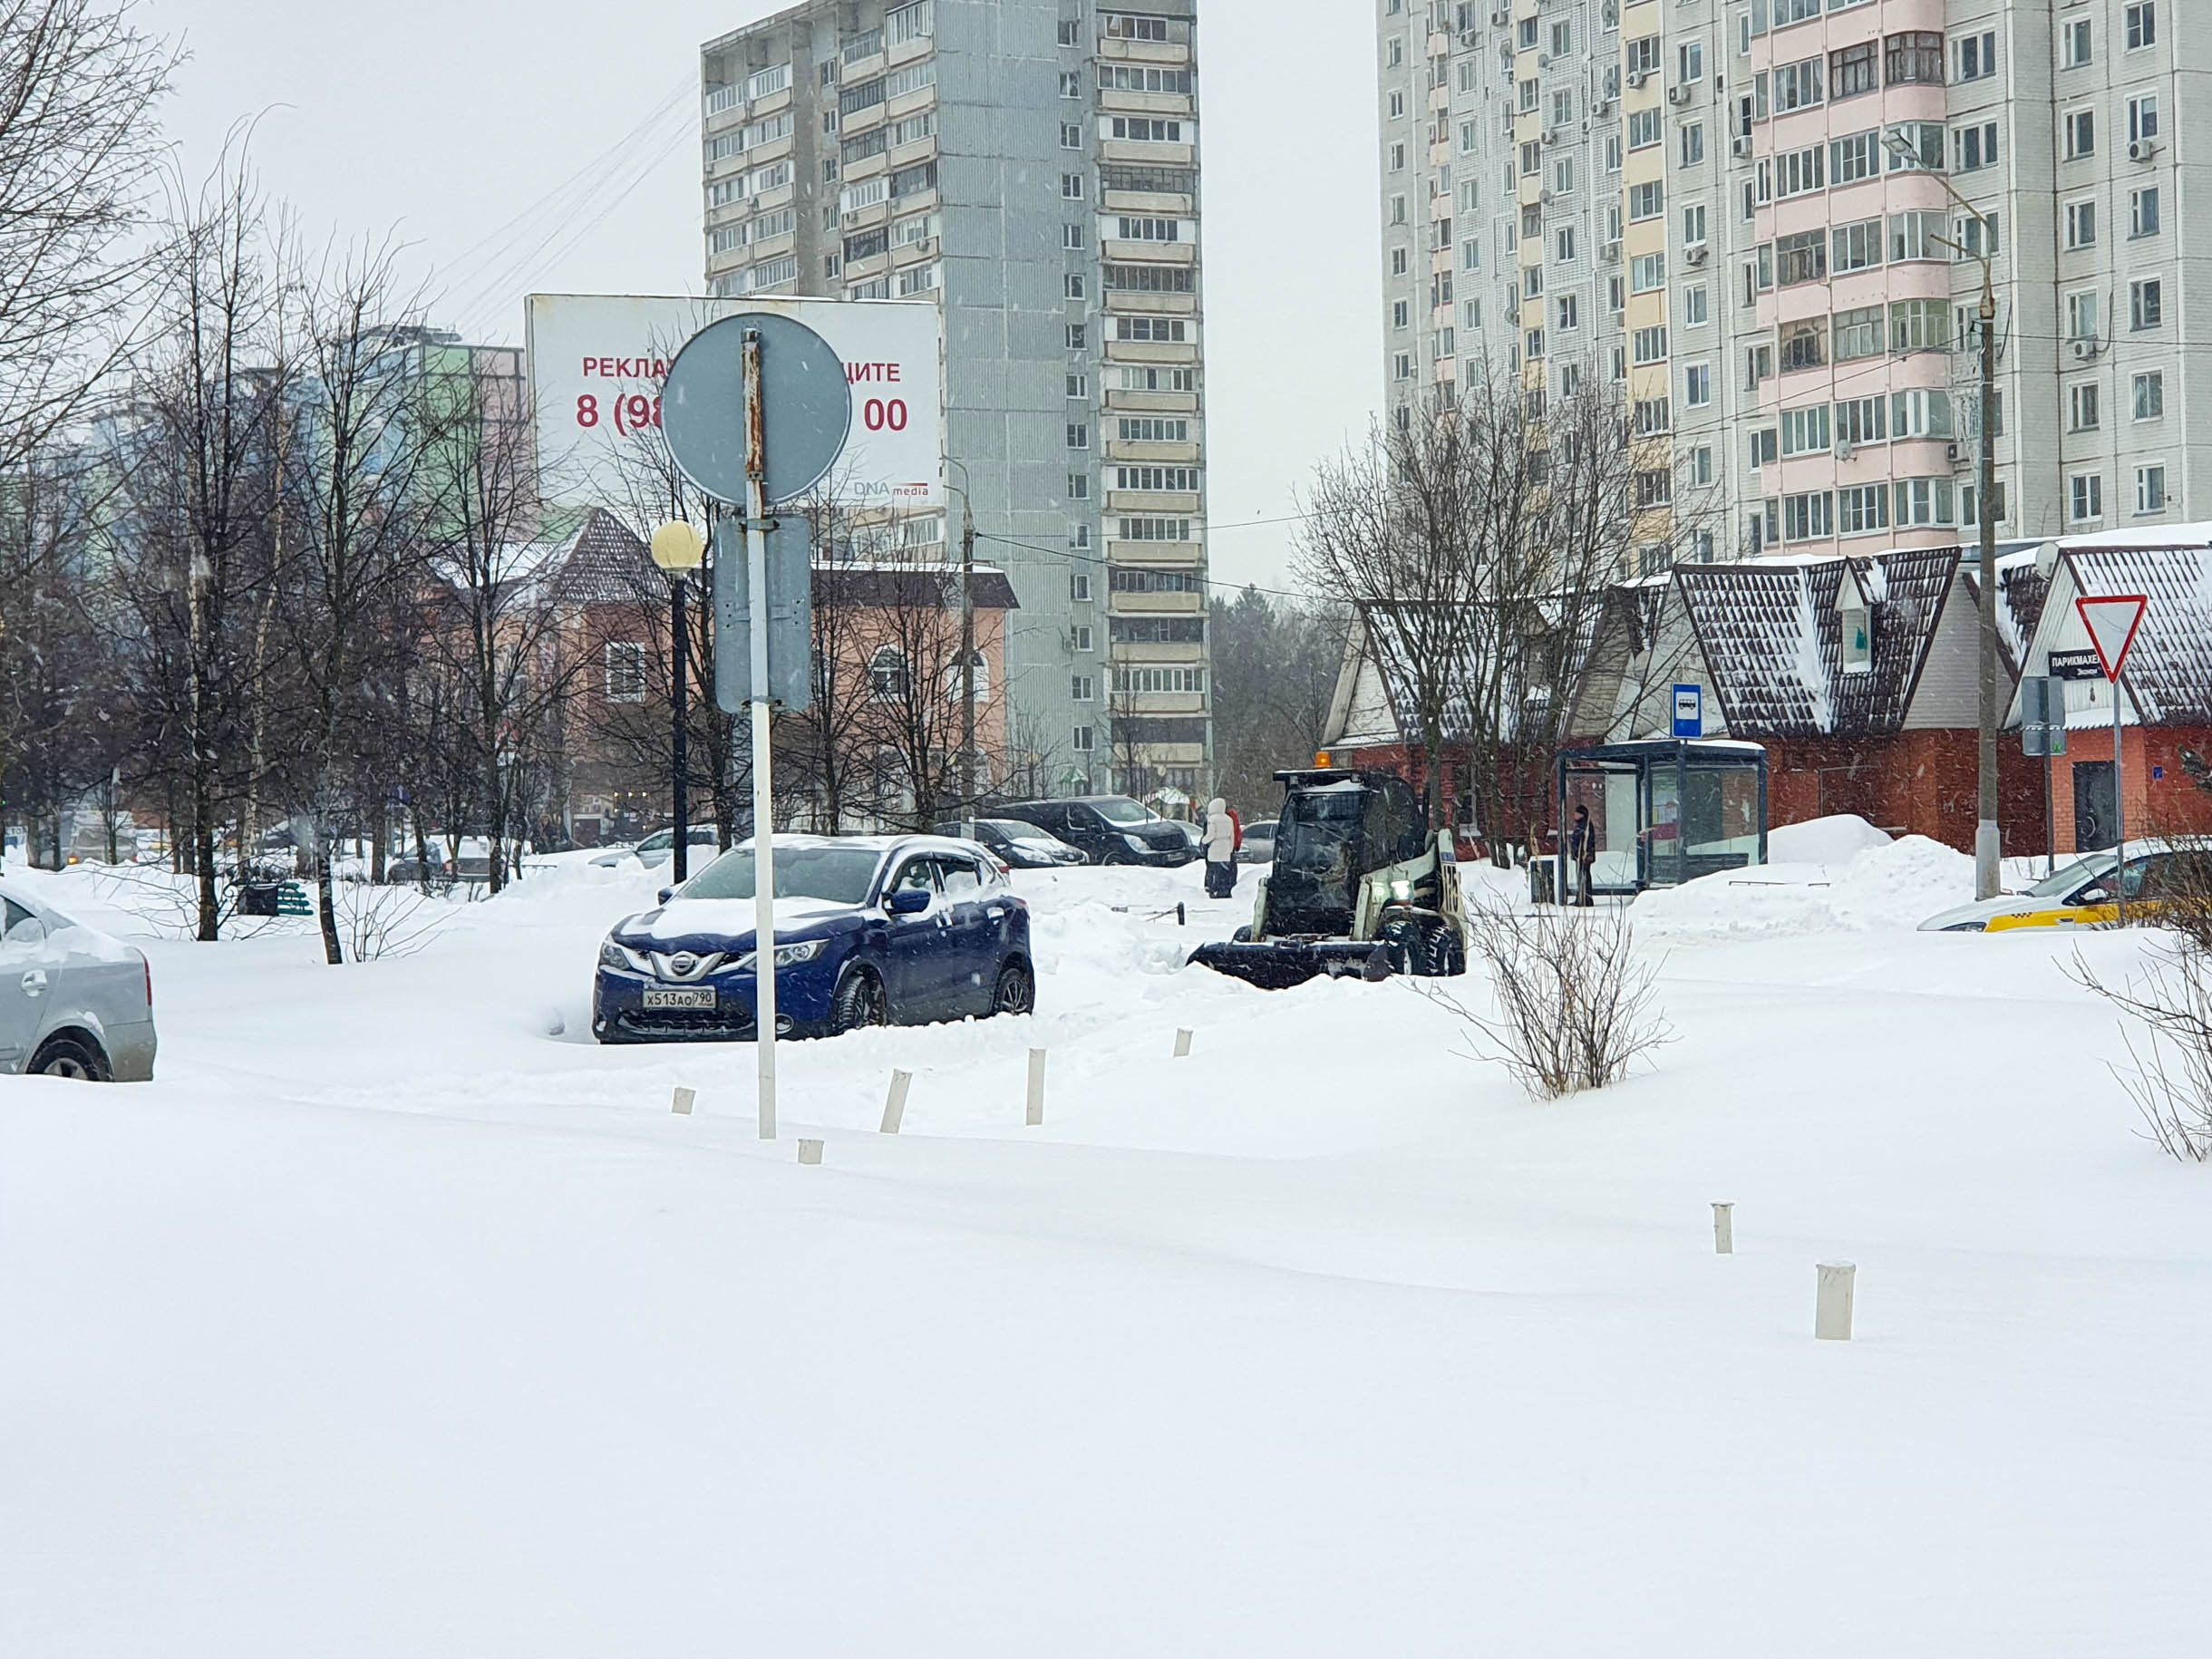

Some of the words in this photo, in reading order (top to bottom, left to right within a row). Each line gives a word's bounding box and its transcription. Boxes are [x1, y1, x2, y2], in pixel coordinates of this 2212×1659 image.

[583, 357, 674, 378] РЕКЛА
[577, 393, 598, 428] 8
[864, 398, 907, 432] 00
[854, 481, 890, 496] DNA
[893, 487, 929, 496] media
[2052, 654, 2101, 667] ПАРИКМАХЕ
